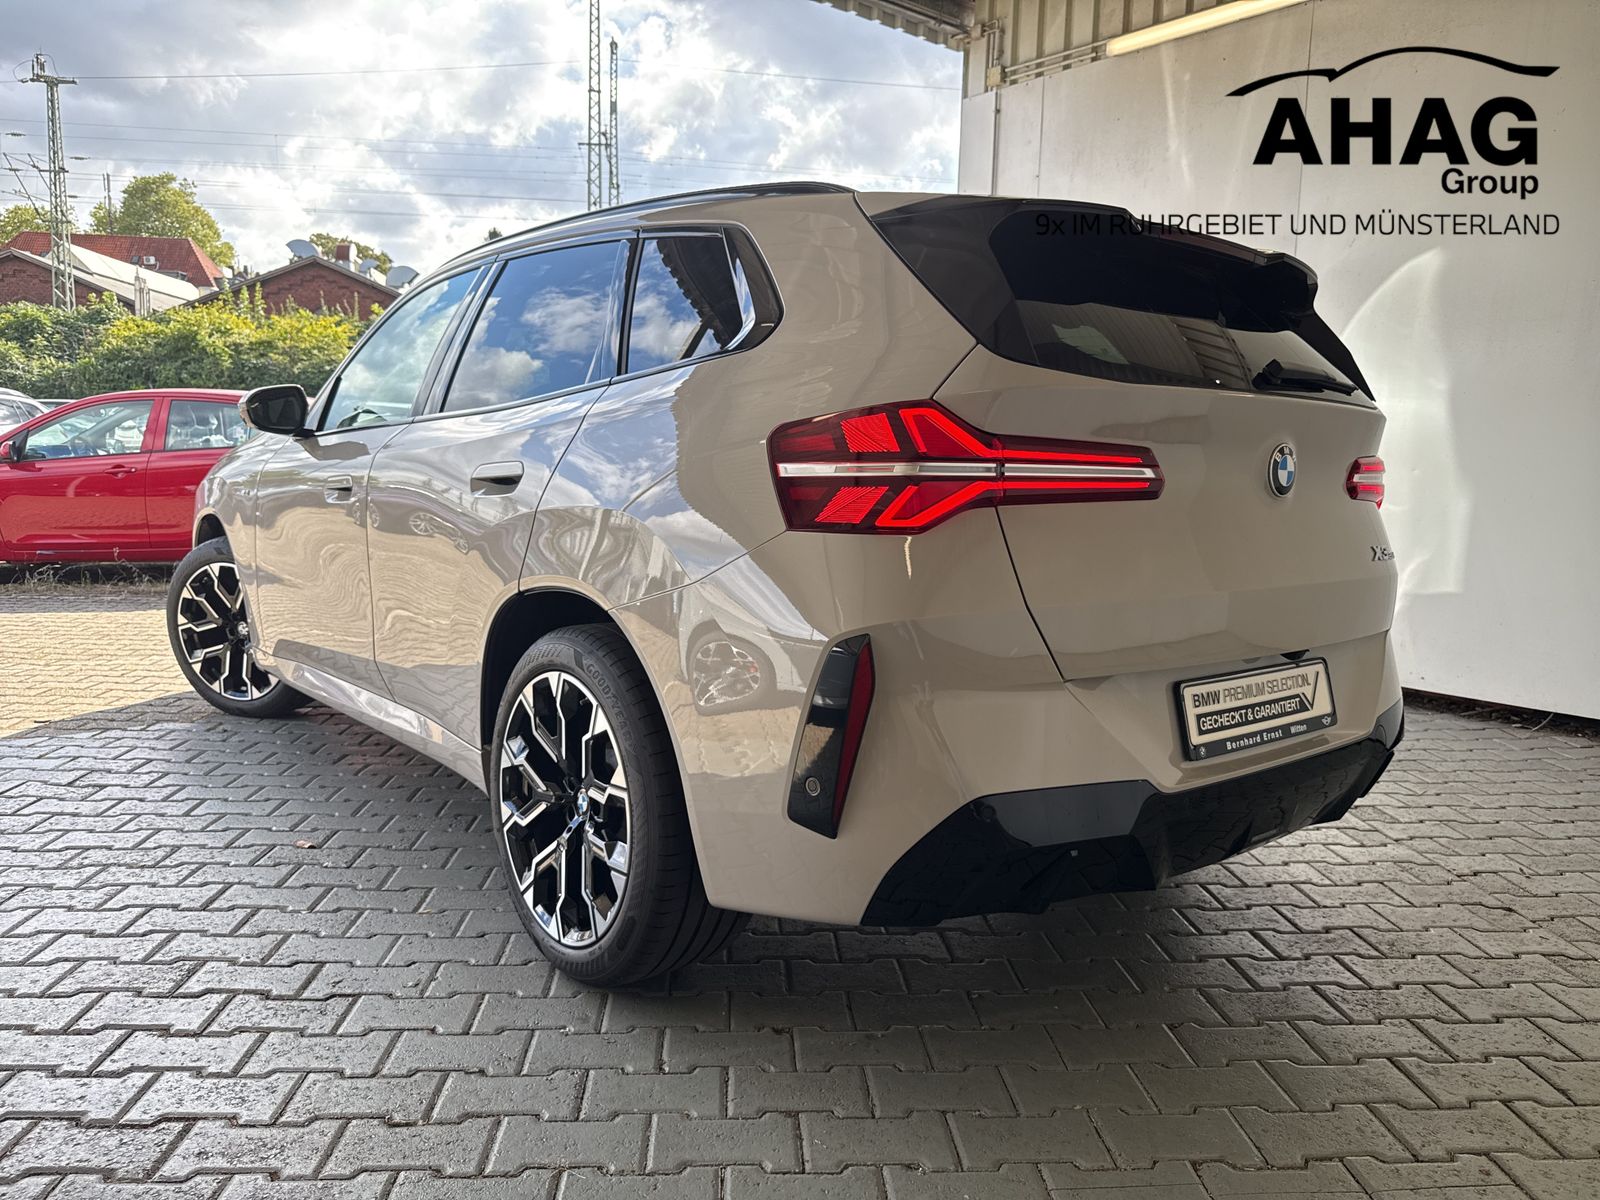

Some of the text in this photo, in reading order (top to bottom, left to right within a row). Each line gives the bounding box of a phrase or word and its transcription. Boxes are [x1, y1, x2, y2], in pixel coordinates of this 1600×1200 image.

[1193, 690, 1220, 708] BMW
[1223, 681, 1266, 703] PREMIUM
[1200, 698, 1300, 731] GECHECKT & GARANTIERT
[1226, 724, 1307, 750] Bernhard Ernst Witten
